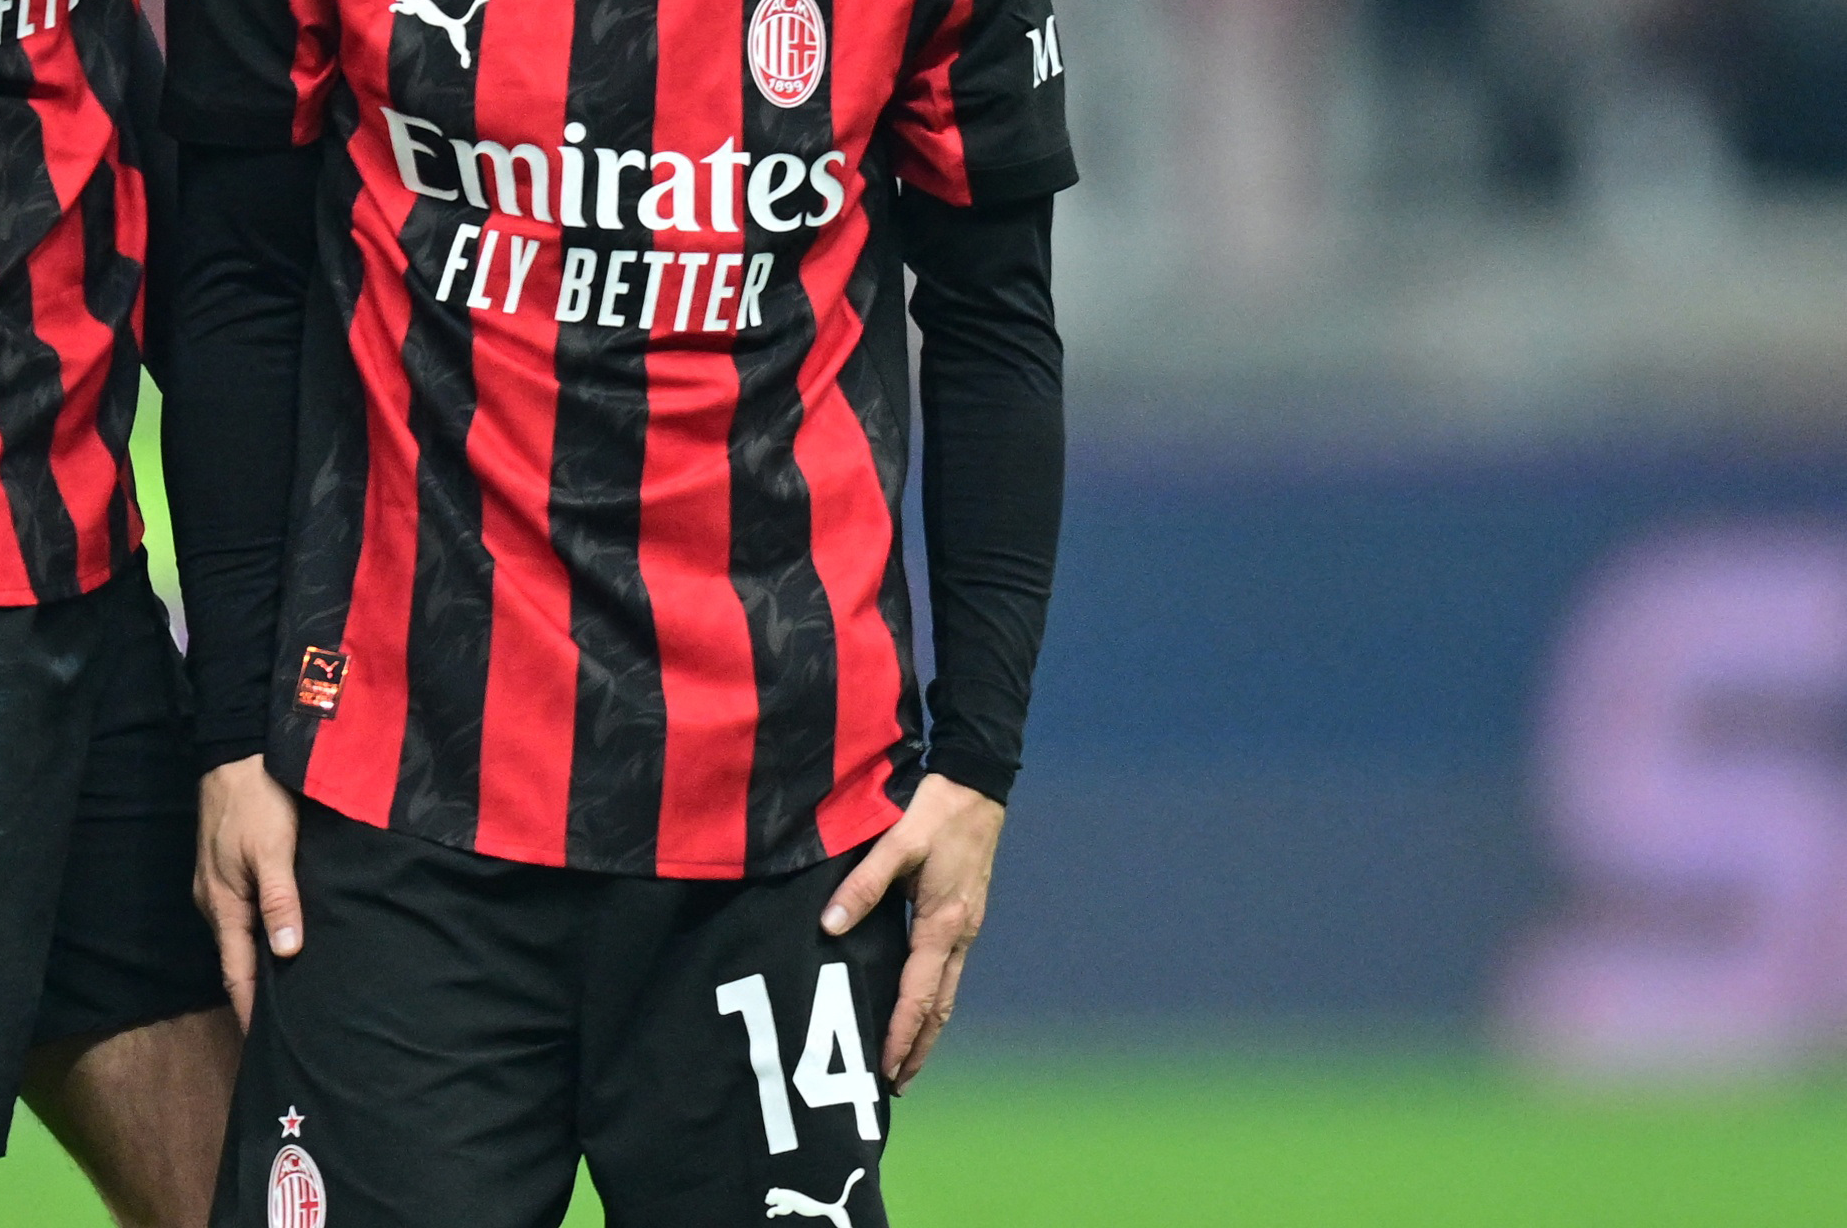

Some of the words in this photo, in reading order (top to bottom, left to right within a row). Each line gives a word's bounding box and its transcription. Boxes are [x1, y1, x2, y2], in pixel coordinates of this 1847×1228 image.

[767, 77, 805, 93] 1899
[379, 105, 848, 234] Emirates
[434, 222, 541, 315] FLY
[555, 246, 776, 333] BETTER
[715, 961, 882, 1156] 14
